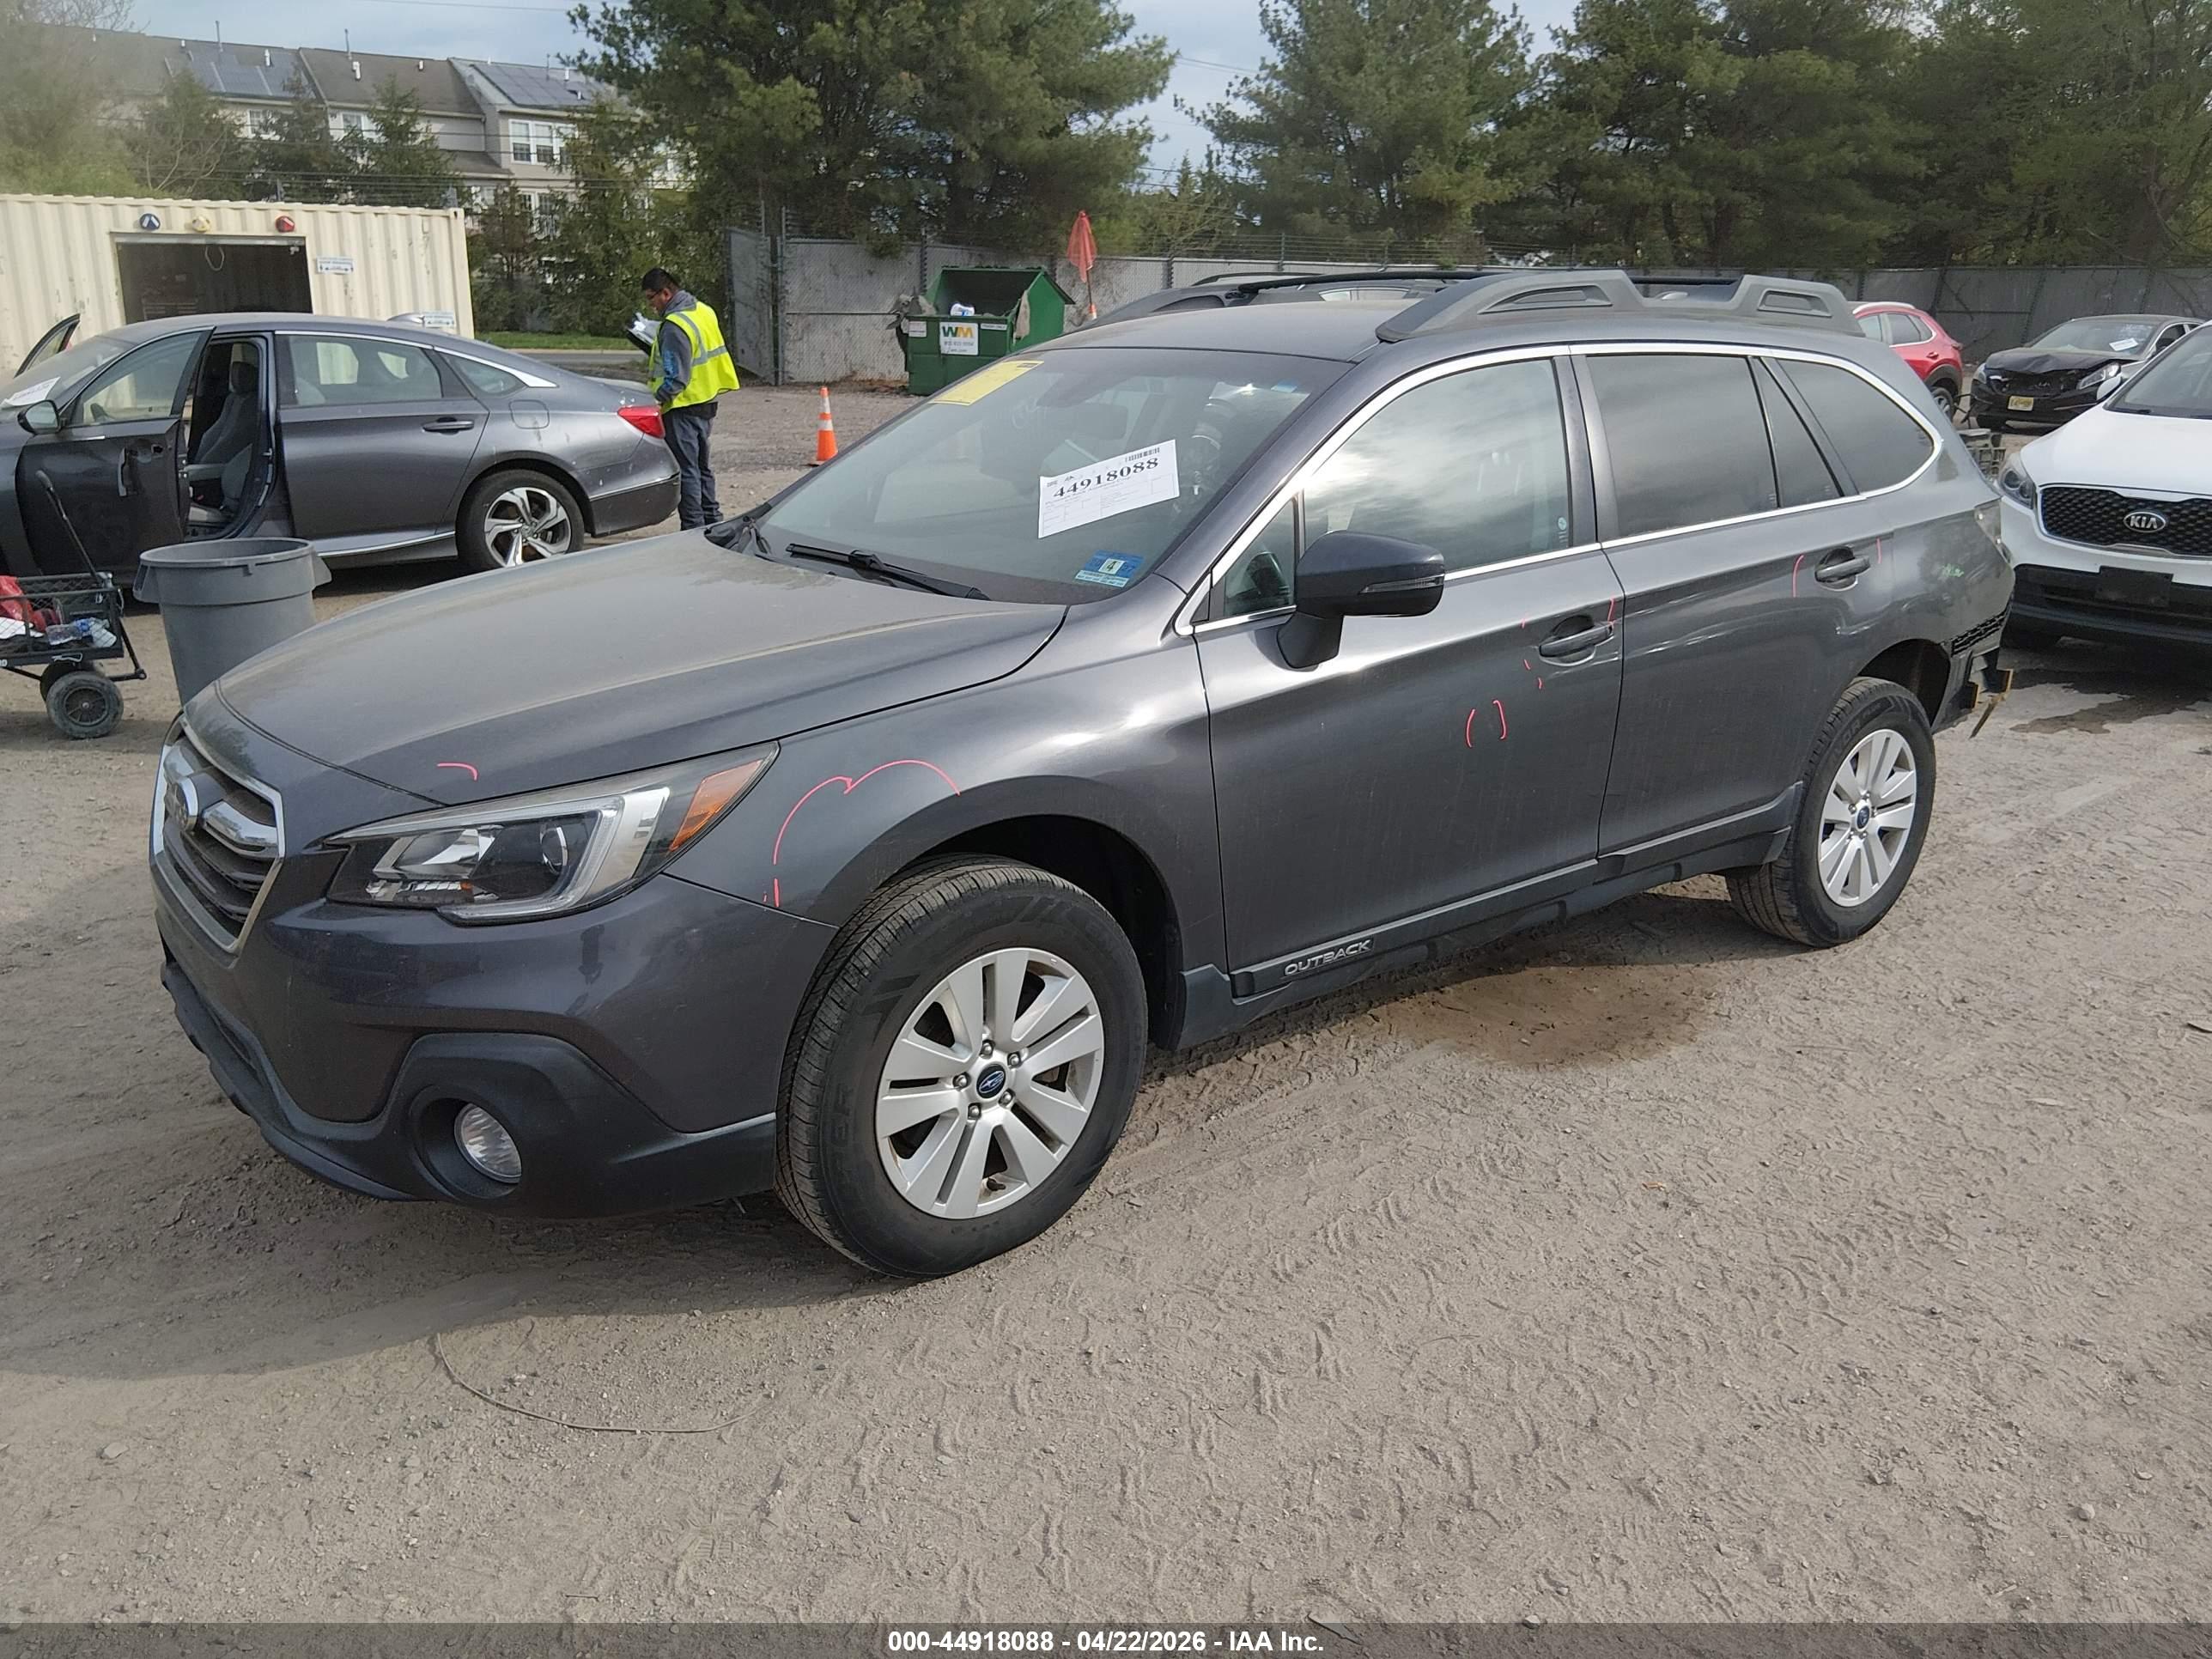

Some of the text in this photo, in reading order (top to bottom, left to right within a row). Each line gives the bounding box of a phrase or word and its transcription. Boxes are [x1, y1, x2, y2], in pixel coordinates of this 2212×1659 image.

[942, 326, 973, 337] WM
[1053, 457, 1159, 497] 44918088
[2130, 515, 2157, 529] KIA
[1107, 560, 1117, 572] 4
[1285, 939, 1371, 975] OUTBACK
